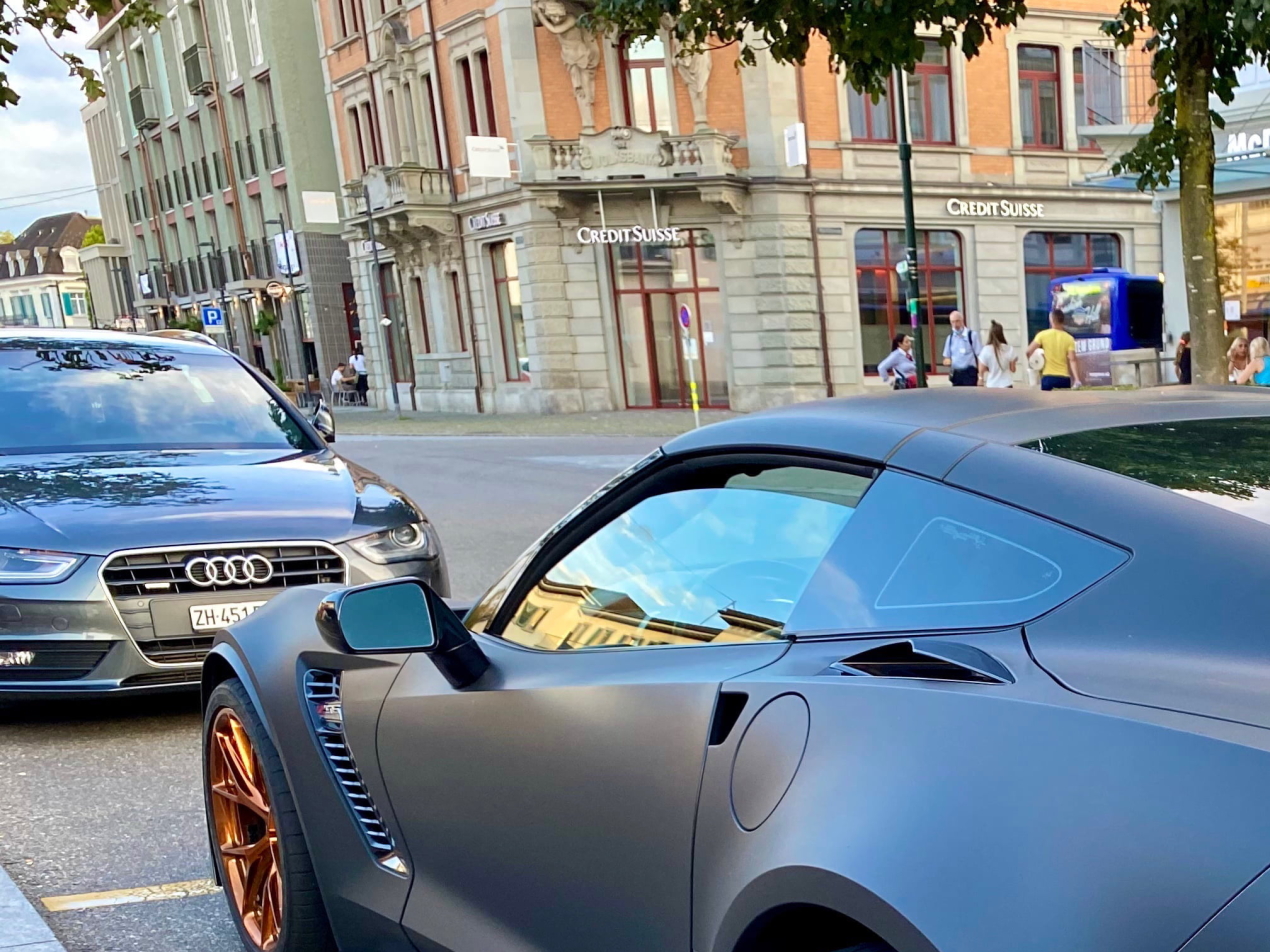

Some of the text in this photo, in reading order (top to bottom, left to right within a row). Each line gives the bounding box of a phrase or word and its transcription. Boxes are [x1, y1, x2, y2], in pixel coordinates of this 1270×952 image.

[946, 198, 1045, 217] CREDIT SUISSE
[576, 225, 680, 244] CREDIT SUISSE
[207, 310, 217, 324] P
